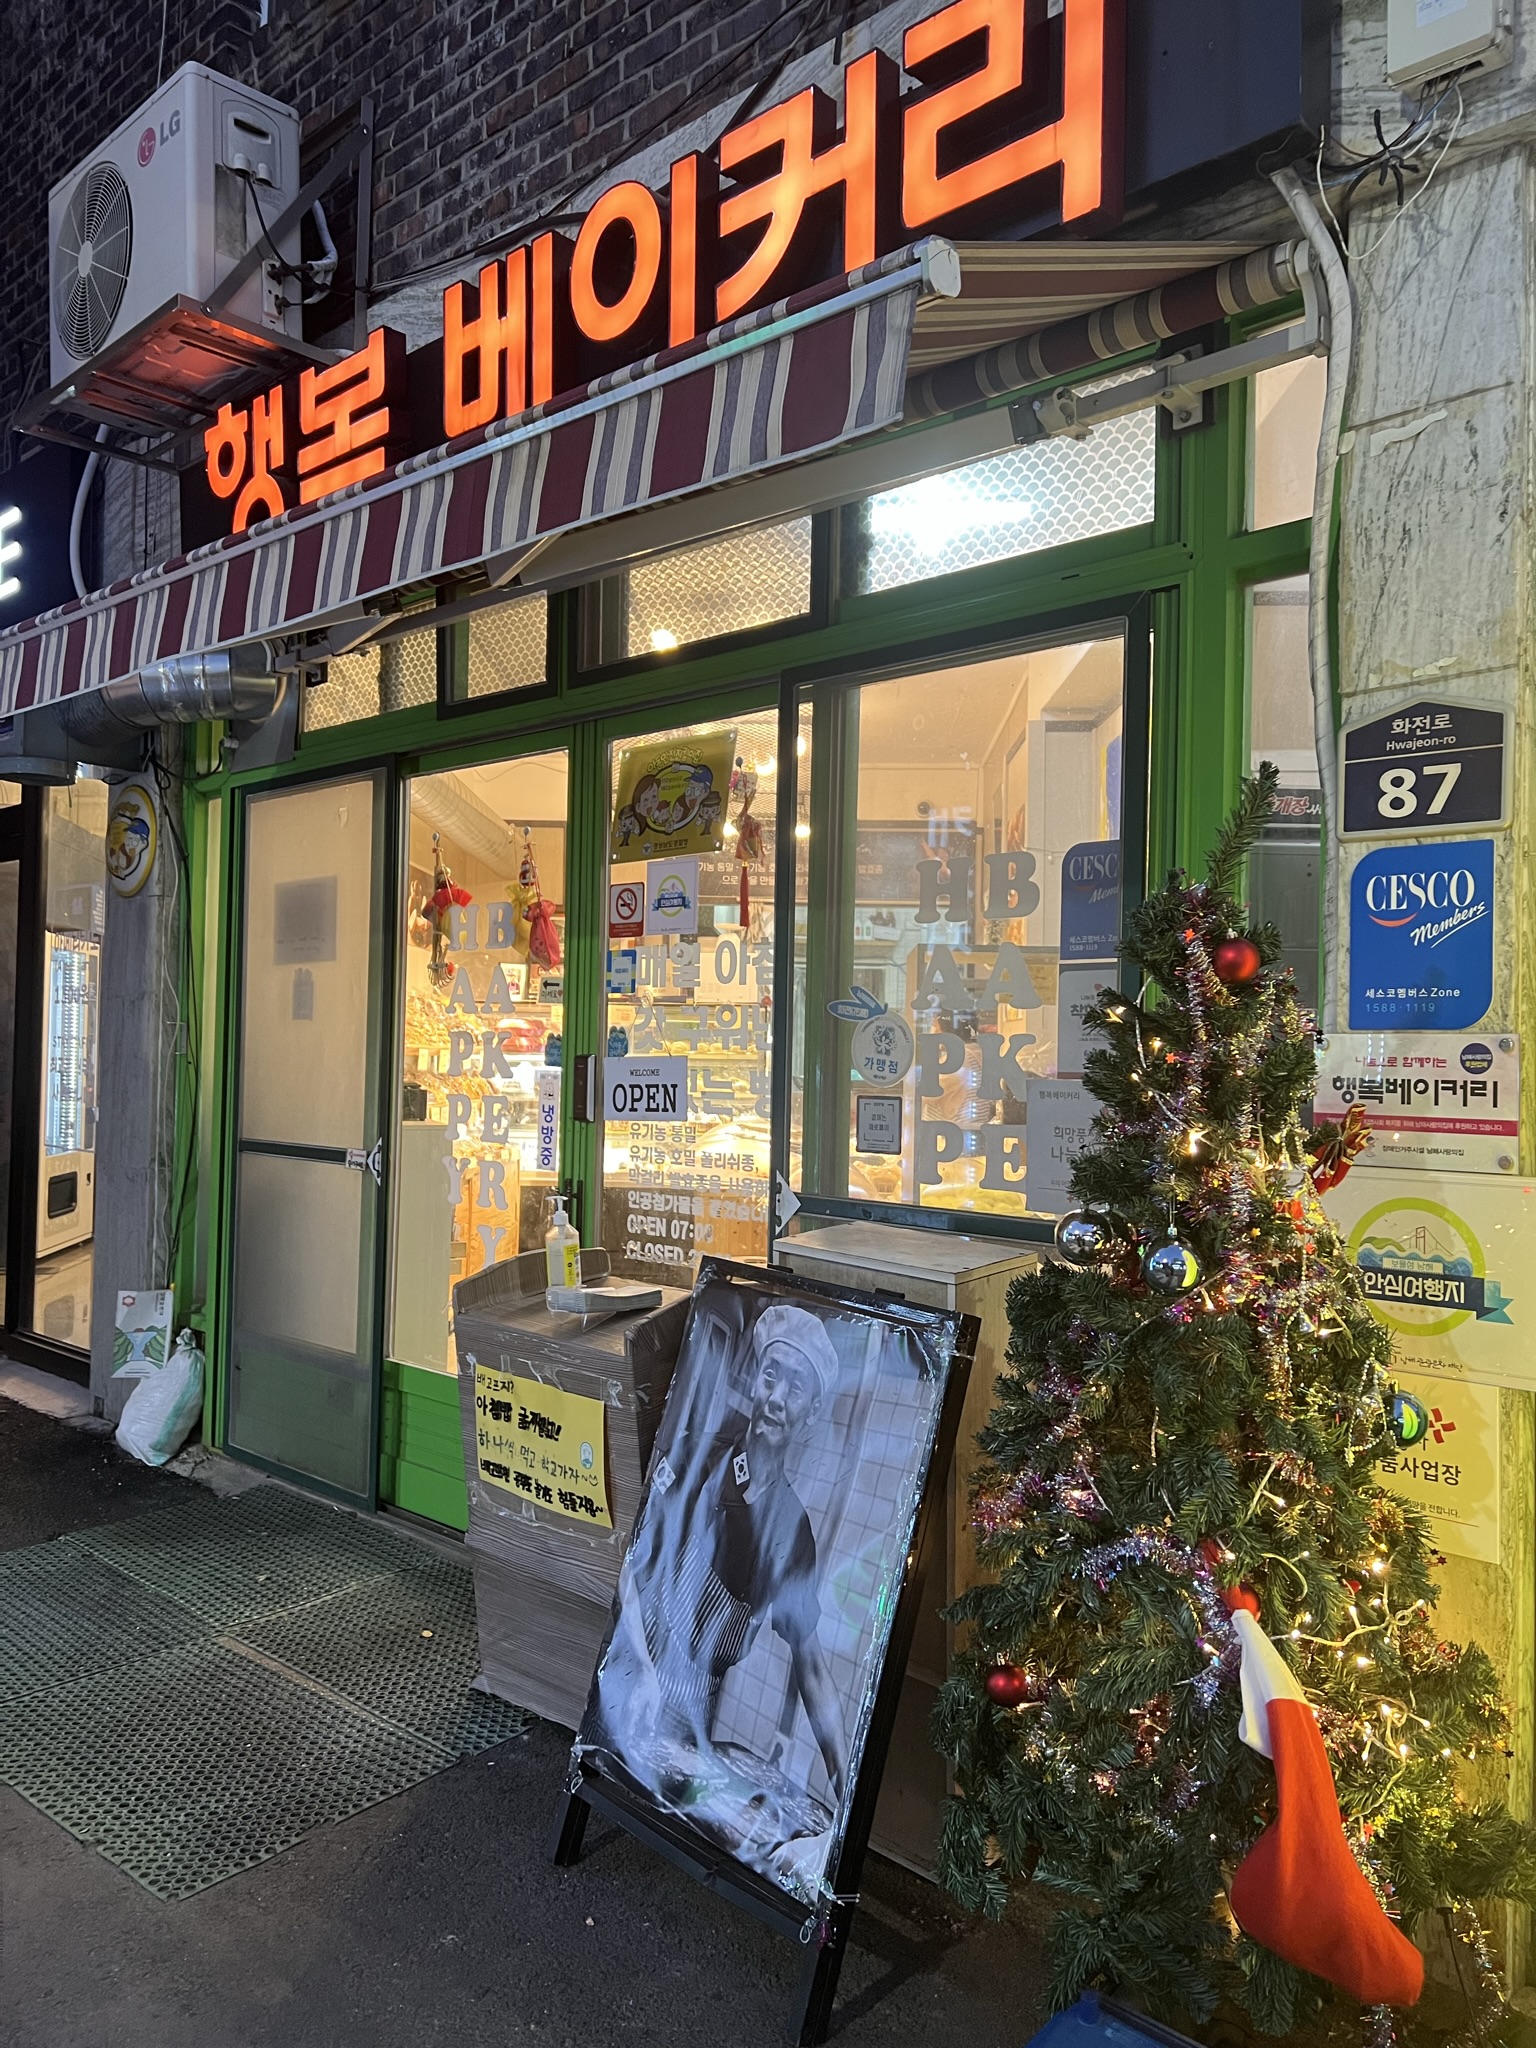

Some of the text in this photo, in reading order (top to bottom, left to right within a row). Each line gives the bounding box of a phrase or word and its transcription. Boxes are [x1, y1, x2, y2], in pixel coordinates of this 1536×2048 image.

[159, 109, 181, 147] LG
[204, 0, 1105, 534] 행복 베이커리
[1390, 713, 1453, 736] 화전로
[1386, 735, 1457, 751] Hwajeon-ro
[1377, 762, 1462, 819] 87
[1271, 795, 1310, 816] 개장
[698, 861, 715, 872] 기농
[747, 861, 765, 873] 기농
[1366, 869, 1476, 913] CESCO
[1410, 901, 1486, 946] Members
[636, 942, 701, 988] 매일
[1430, 987, 1461, 997] Zone
[629, 1068, 660, 1077] WELCOME
[864, 1056, 898, 1074] 가맹점
[1402, 1056, 1447, 1068] 함께하는
[612, 1083, 678, 1113] OPEN
[1039, 1090, 1081, 1101] 행복베이커리
[1332, 1075, 1498, 1109] 행복베이커리
[540, 1104, 555, 1166] 냉방중
[630, 1122, 697, 1144] 유기농 통밀
[629, 1144, 667, 1165] 유기농
[670, 1148, 696, 1168] 호밀
[626, 1213, 714, 1244] OPEN 07:00
[625, 1240, 684, 1267] CLOSED
[1363, 1271, 1466, 1304] 안심여행지
[1375, 1456, 1462, 1487] 눔사업장
[1427, 1503, 1461, 1519] 전합니다.
